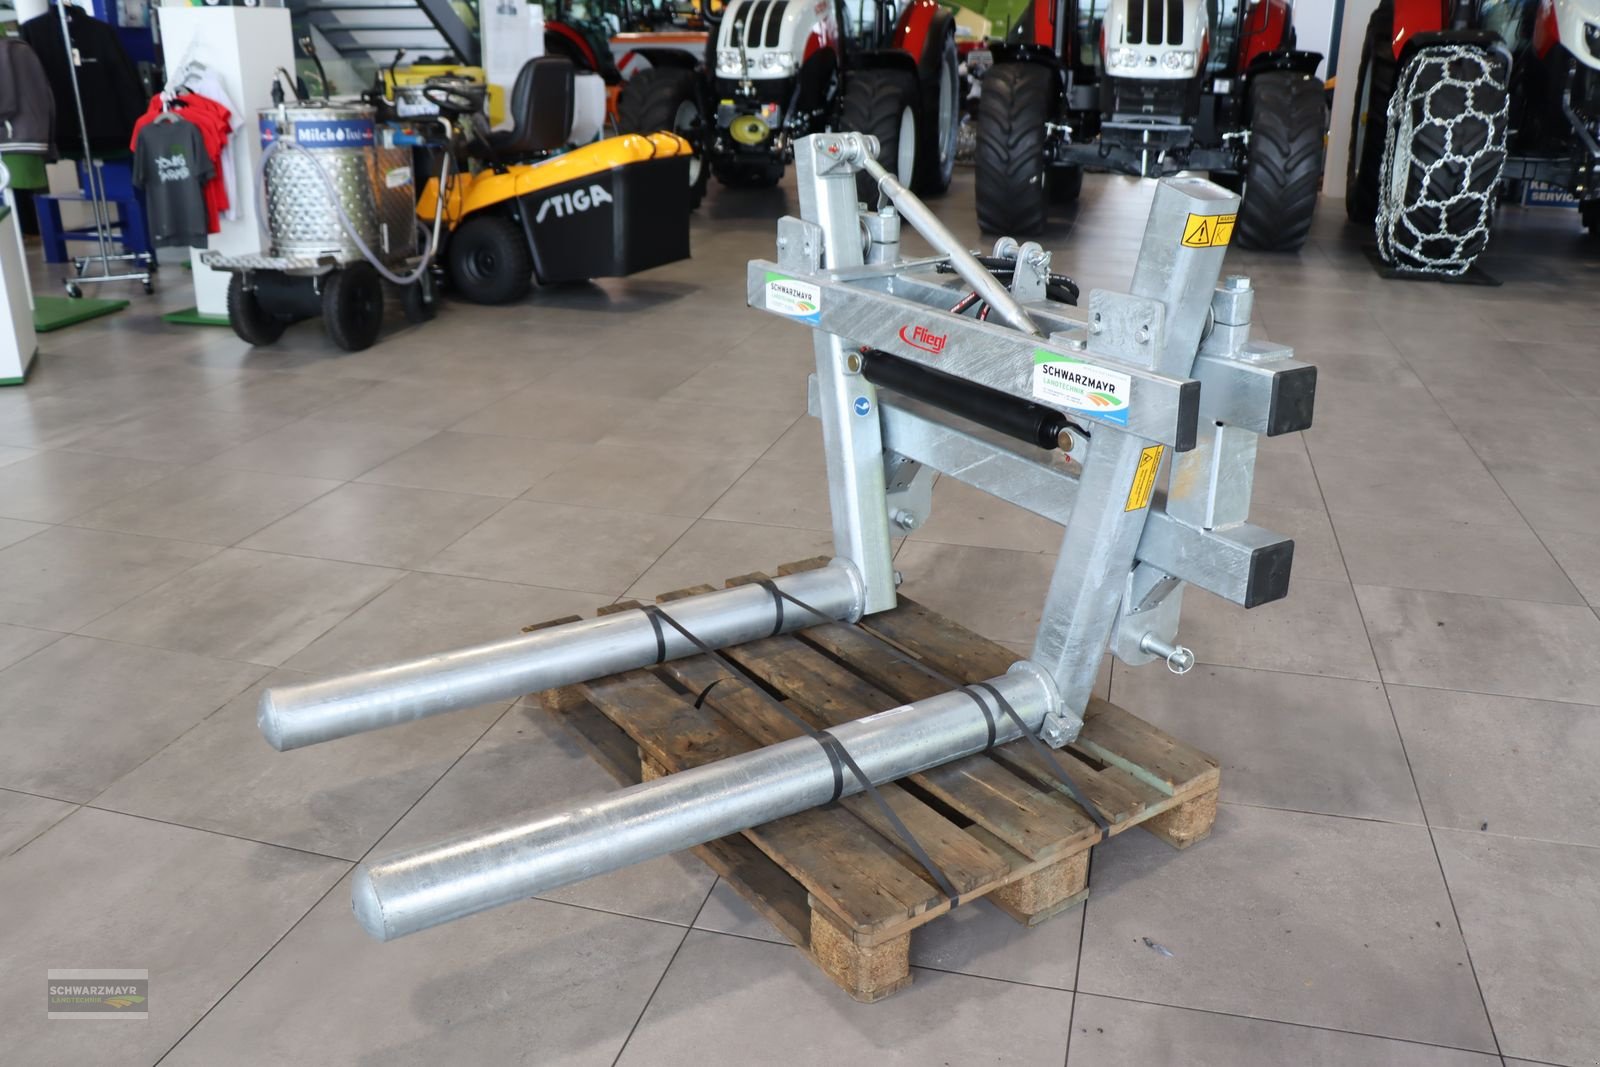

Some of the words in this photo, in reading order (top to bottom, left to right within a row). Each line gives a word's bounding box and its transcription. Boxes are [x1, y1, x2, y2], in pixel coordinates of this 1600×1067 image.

[298, 128, 335, 141] Milch
[536, 184, 613, 223] STIGA
[770, 282, 813, 301] SCHWARZMAYR
[913, 325, 947, 351] Fliegl
[1042, 364, 1116, 394] SCHWARZMAYR
[1043, 377, 1085, 395] LANDTECHNIK
